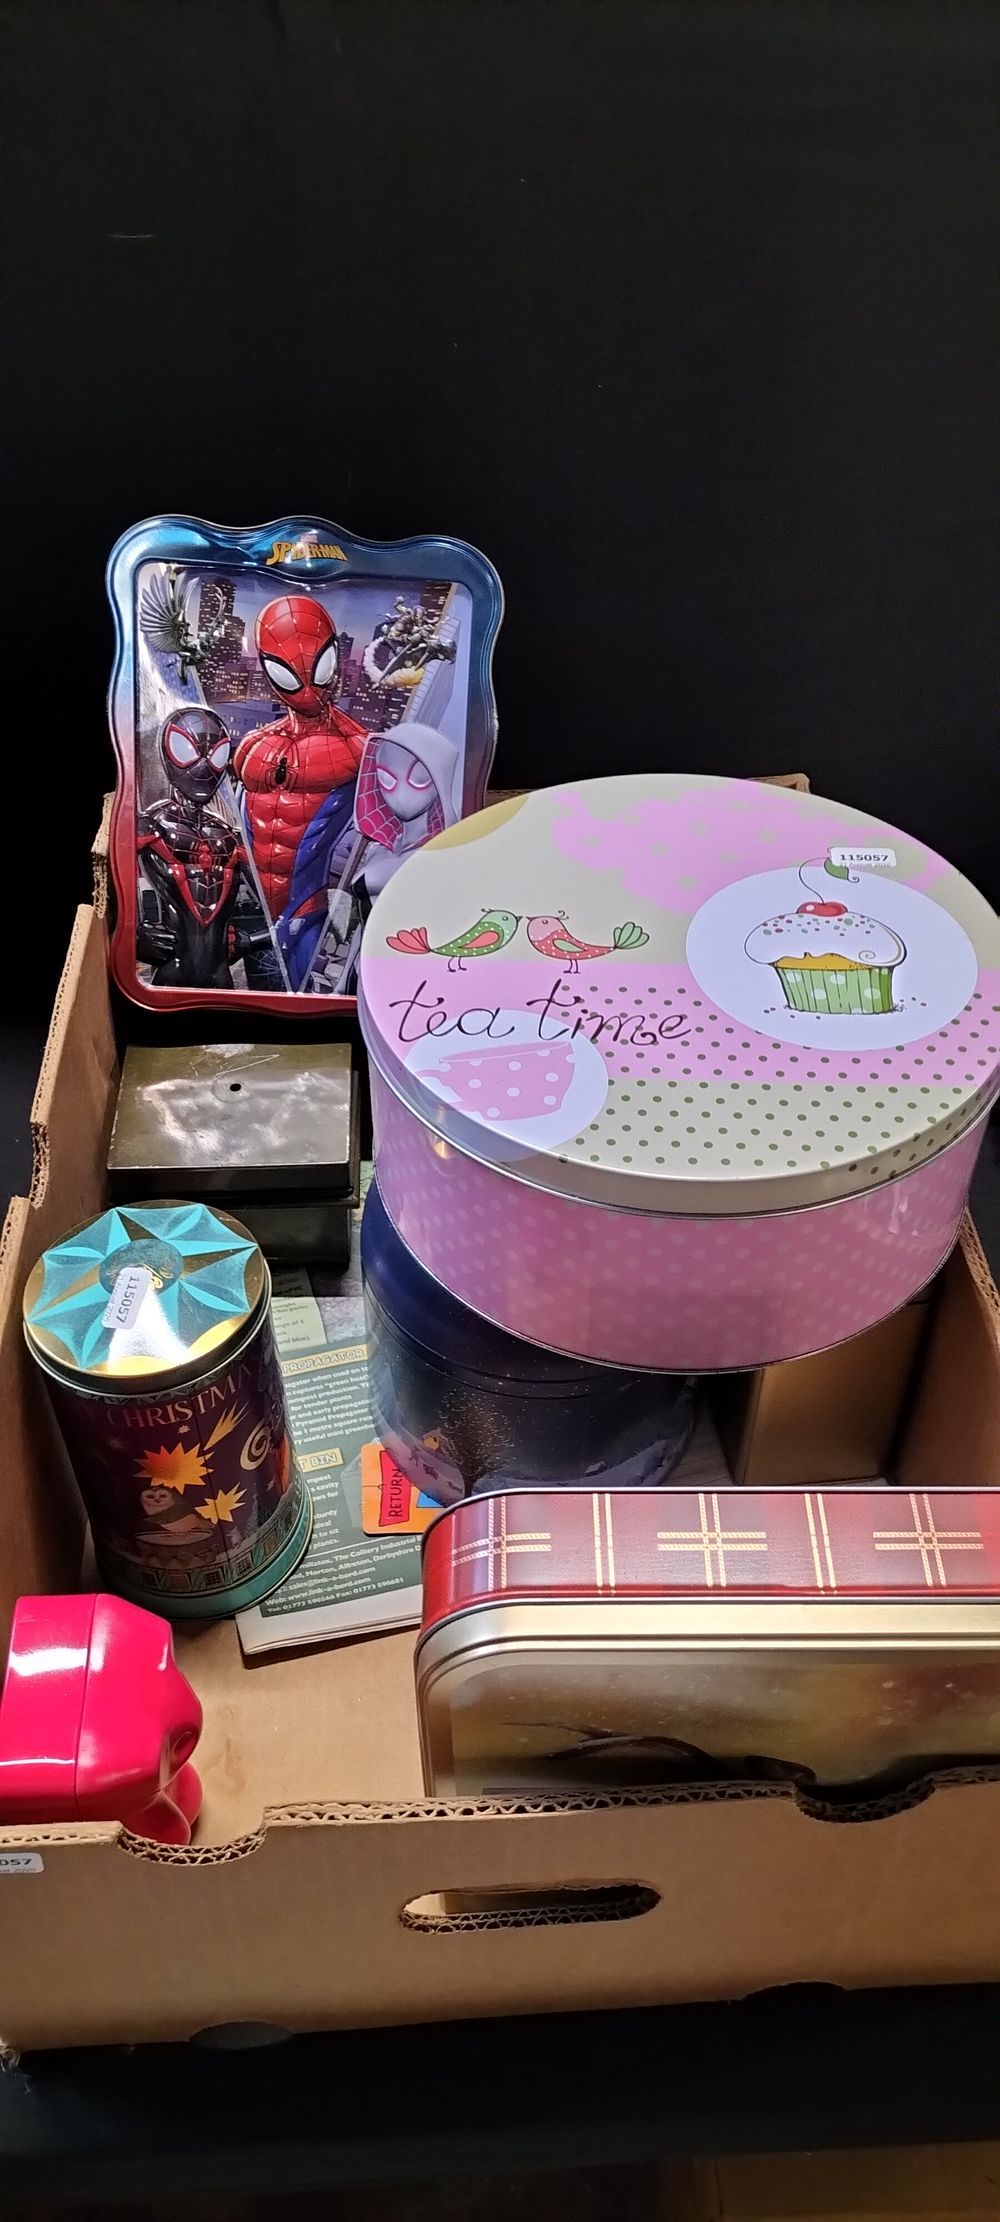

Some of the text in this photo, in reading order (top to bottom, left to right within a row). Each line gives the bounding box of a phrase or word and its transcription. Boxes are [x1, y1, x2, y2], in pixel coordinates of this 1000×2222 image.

[840, 854, 889, 862] 115057
[389, 978, 692, 1046] tea time
[116, 1276, 141, 1324] 115057
[311, 1374, 333, 1382] when
[332, 1369, 350, 1378] used
[292, 1385, 324, 1395] captures
[303, 1399, 328, 1409] tender
[329, 1394, 353, 1404] plants
[295, 1415, 327, 1427] Pyramid
[327, 1407, 370, 1420] Propagator
[297, 1410, 313, 1418] and
[313, 1407, 332, 1416] early
[309, 1424, 333, 1433] metre
[333, 1418, 358, 1428] square
[303, 1432, 327, 1443] useful
[310, 1451, 338, 1468] BIN
[316, 1481, 340, 1491] cavity
[388, 1468, 404, 1517] RETURN
[333, 1553, 350, 1562] The
[350, 1546, 380, 1558] Colliery
[380, 1536, 416, 1550] Industrial
[305, 1567, 338, 1577] Morton,
[338, 1558, 373, 1570] Alfreton,
[372, 1547, 415, 1562] Derbyshire
[287, 1577, 372, 1600] www.link-a-bord.com
[353, 1583, 377, 1594] 01773
